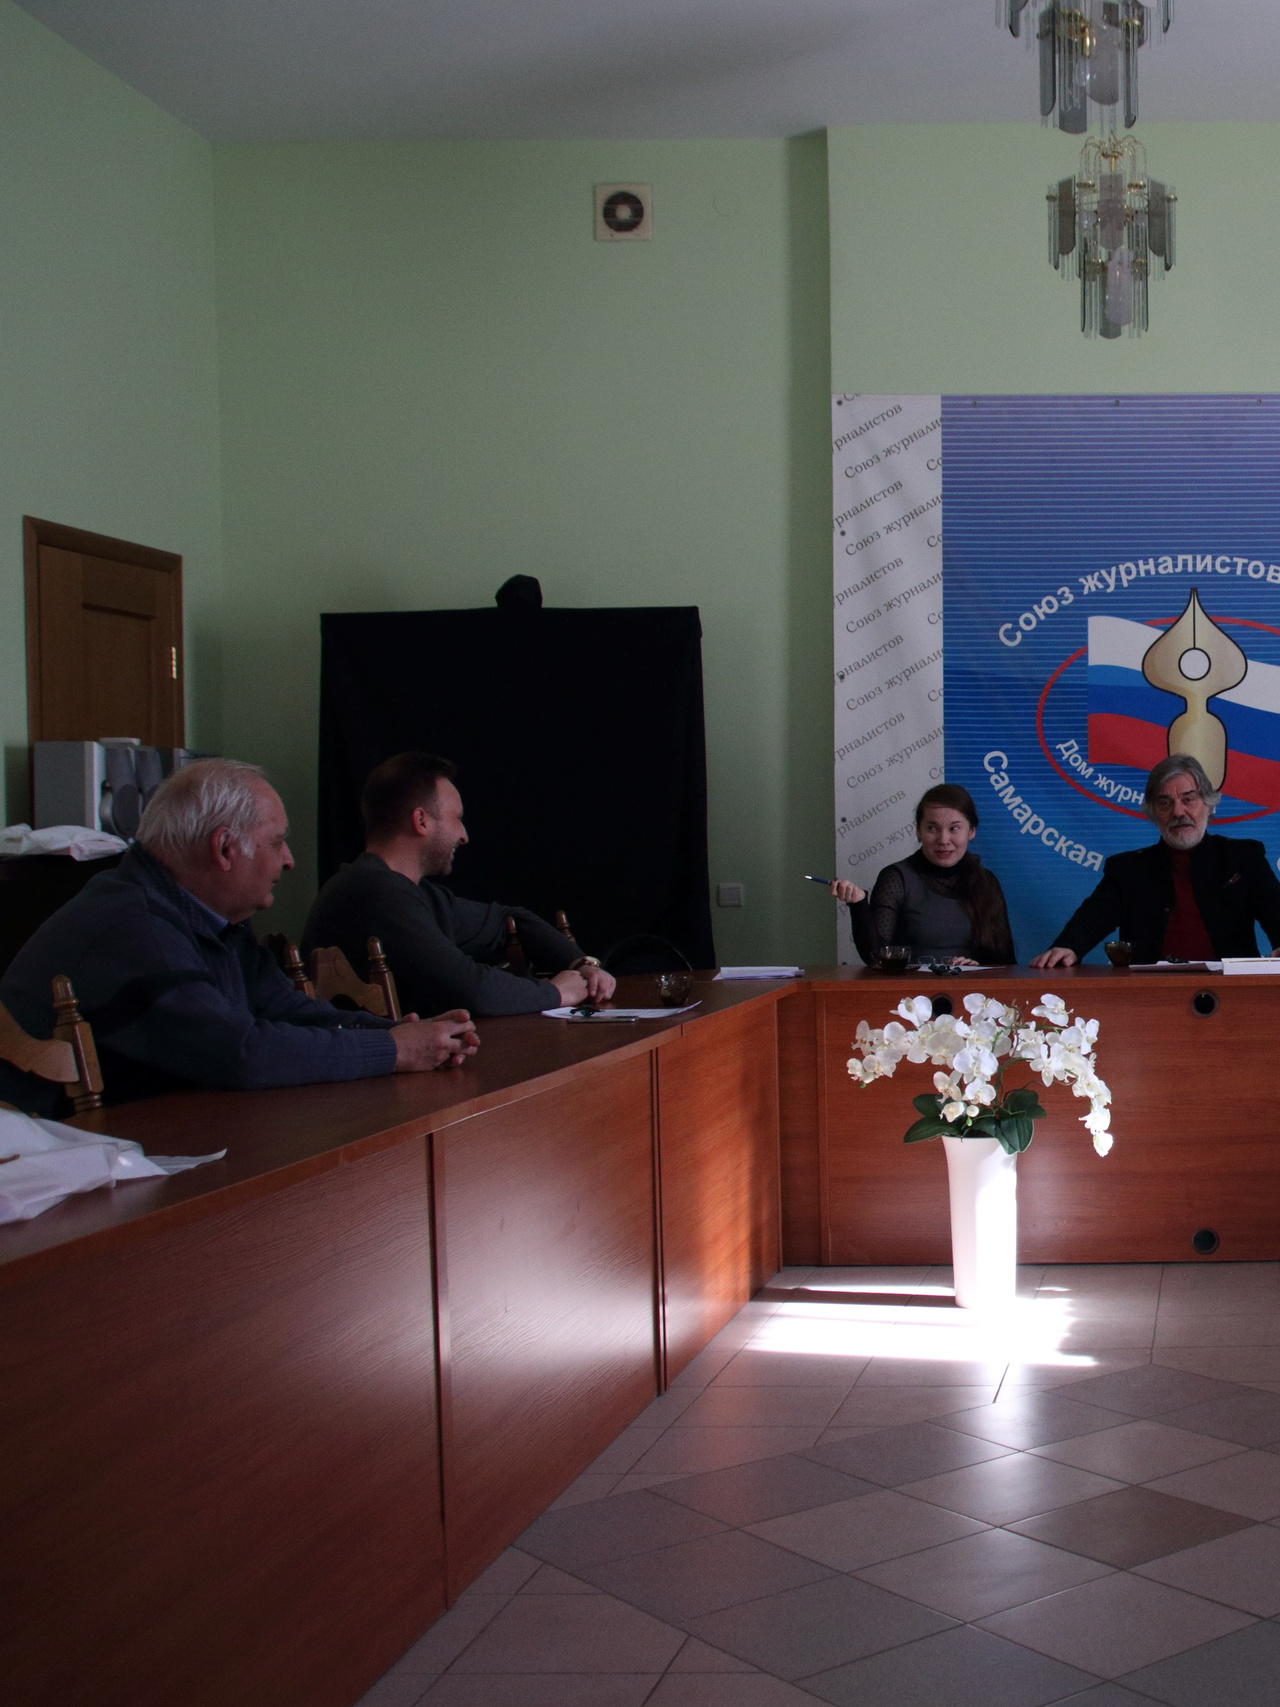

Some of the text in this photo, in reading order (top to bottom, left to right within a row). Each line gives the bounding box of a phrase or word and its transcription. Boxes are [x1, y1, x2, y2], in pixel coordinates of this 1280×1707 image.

[844, 454, 881, 479] Союз
[845, 530, 881, 556] Союз
[845, 608, 882, 633] Союз
[999, 586, 1074, 647] Союз
[846, 686, 883, 711] Союз
[846, 764, 884, 789] Союз
[1055, 739, 1145, 805] Дом журн
[983, 751, 1104, 872] Самарская
[848, 841, 885, 867] Союз
